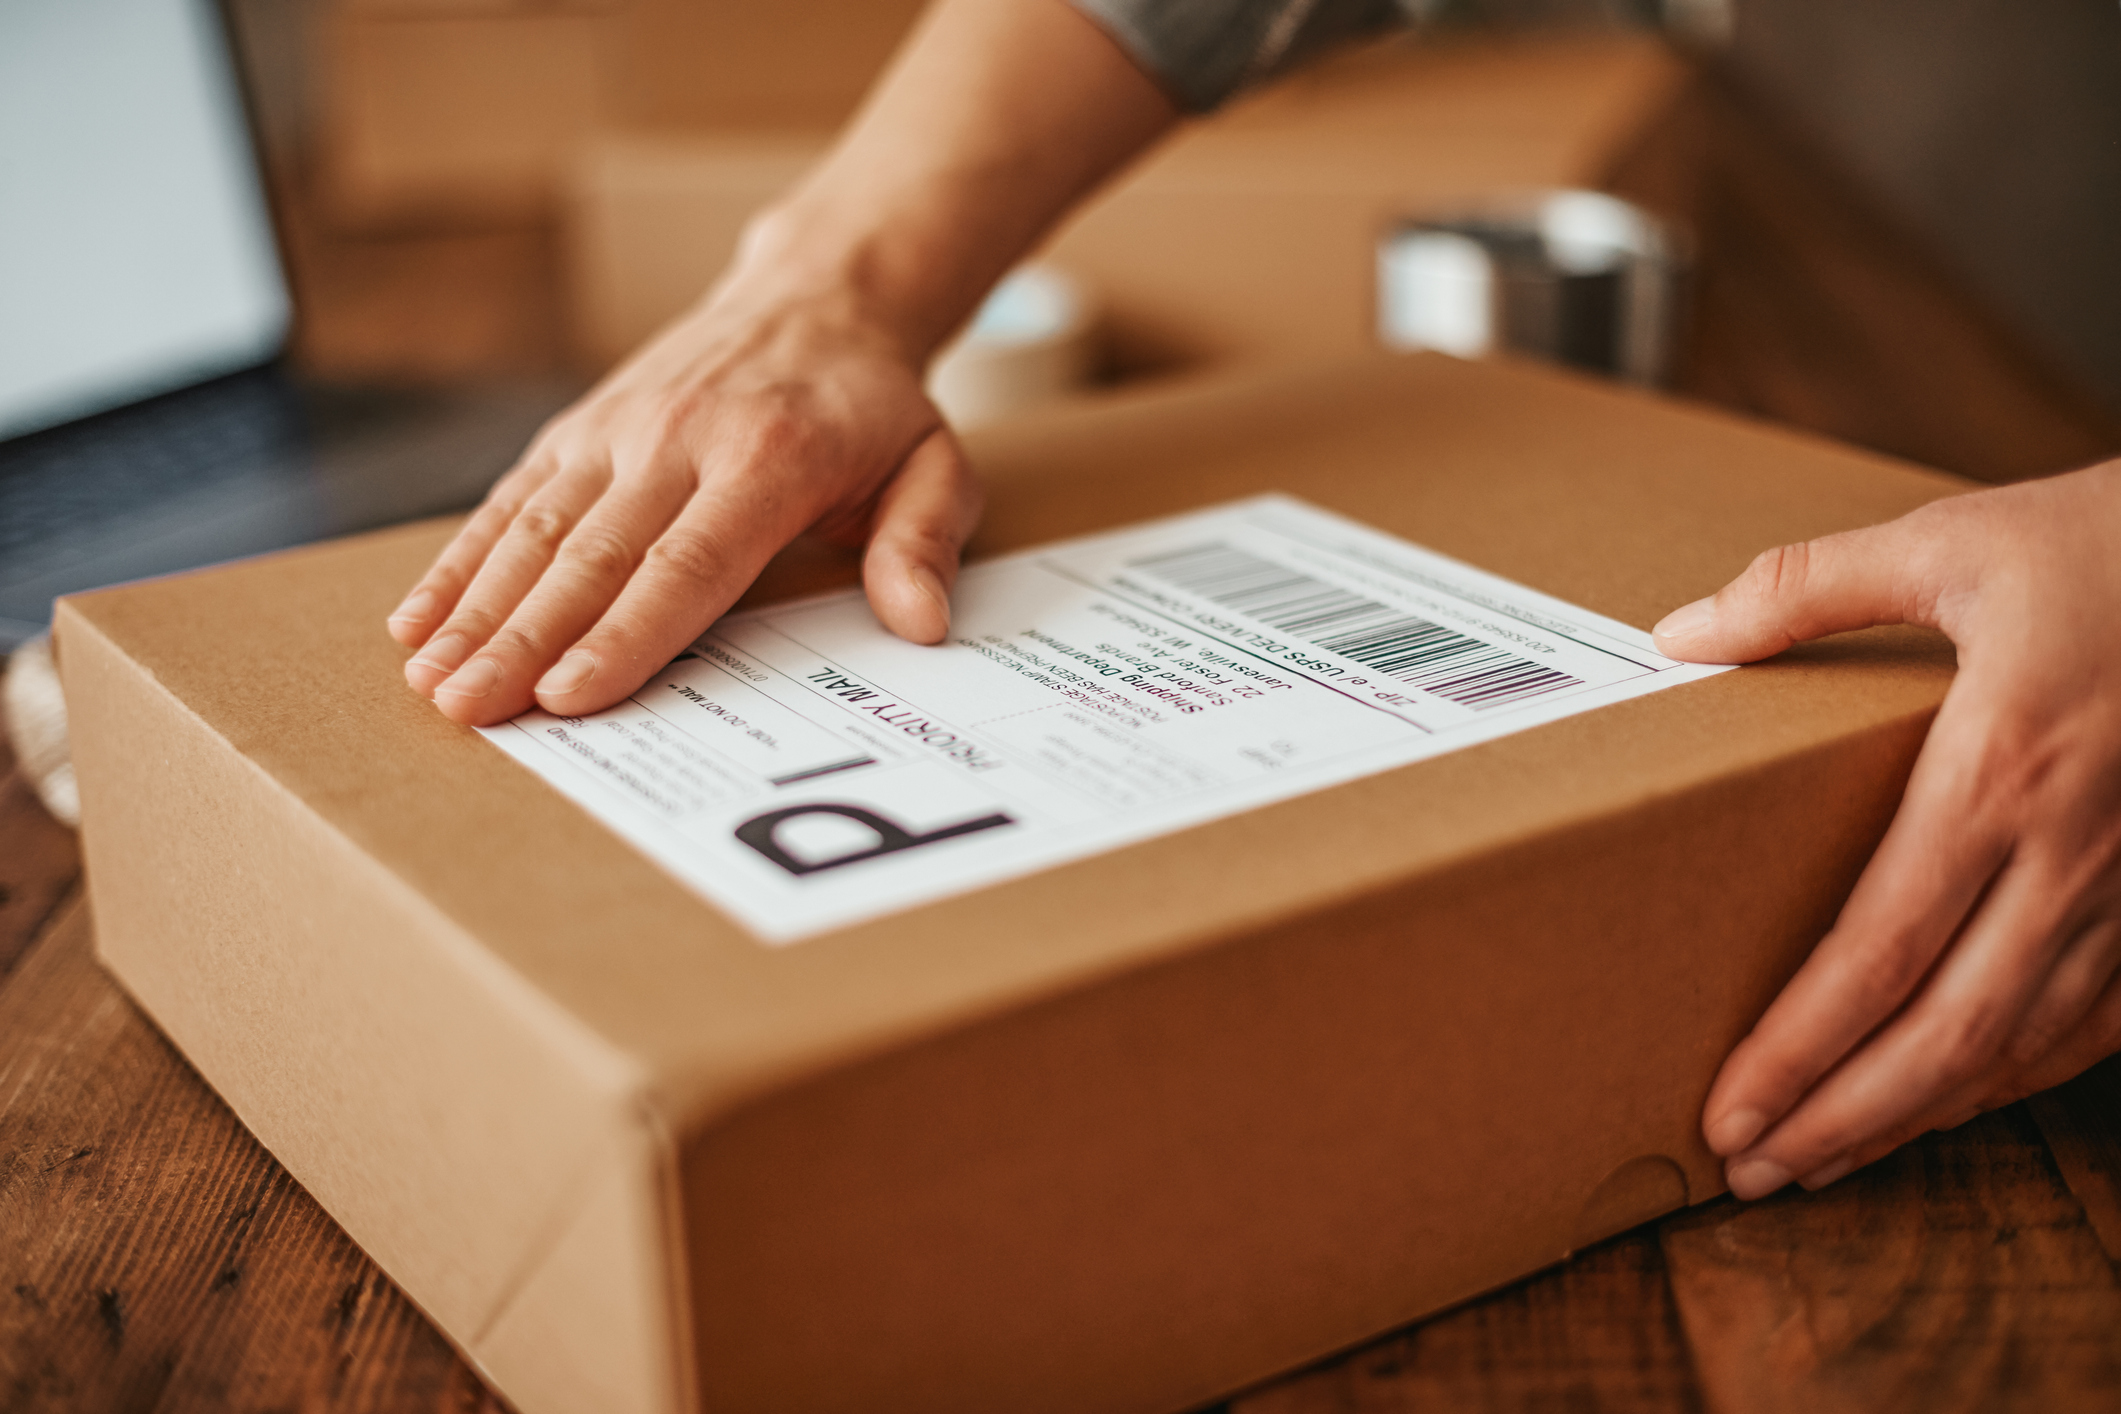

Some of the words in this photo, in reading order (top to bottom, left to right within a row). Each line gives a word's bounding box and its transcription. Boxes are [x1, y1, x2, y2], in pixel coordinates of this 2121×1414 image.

[1164, 637, 1192, 649] WI
[1196, 615, 1290, 654] DELIVERY
[1524, 641, 1557, 653] 420
[951, 636, 1029, 672] NECESSARY
[997, 643, 1052, 668] PREPAID
[1021, 630, 1123, 677] Department
[1096, 644, 1161, 674] Brands
[1137, 643, 1174, 658] Ave
[1047, 665, 1085, 683] BEEN
[1172, 658, 1233, 686] Foster
[1198, 648, 1293, 689] Janesville,
[1283, 652, 1345, 677] USPS
[807, 666, 880, 703] MAIL
[1021, 671, 1068, 691] STAMP
[1077, 681, 1111, 695] HAS
[1119, 674, 1204, 713] Shipping
[1152, 671, 1233, 706] Sanford
[1231, 685, 1264, 699] 22
[698, 702, 726, 716] NOT
[1060, 688, 1122, 718] POSTAGE
[1102, 692, 1168, 723] POSTAGE
[1374, 692, 1417, 706] ZIP
[722, 715, 747, 725] DO
[1117, 716, 1144, 730] NO
[546, 726, 574, 742] PAID
[861, 702, 1003, 772] PRIORITY
[733, 802, 1016, 878] P
